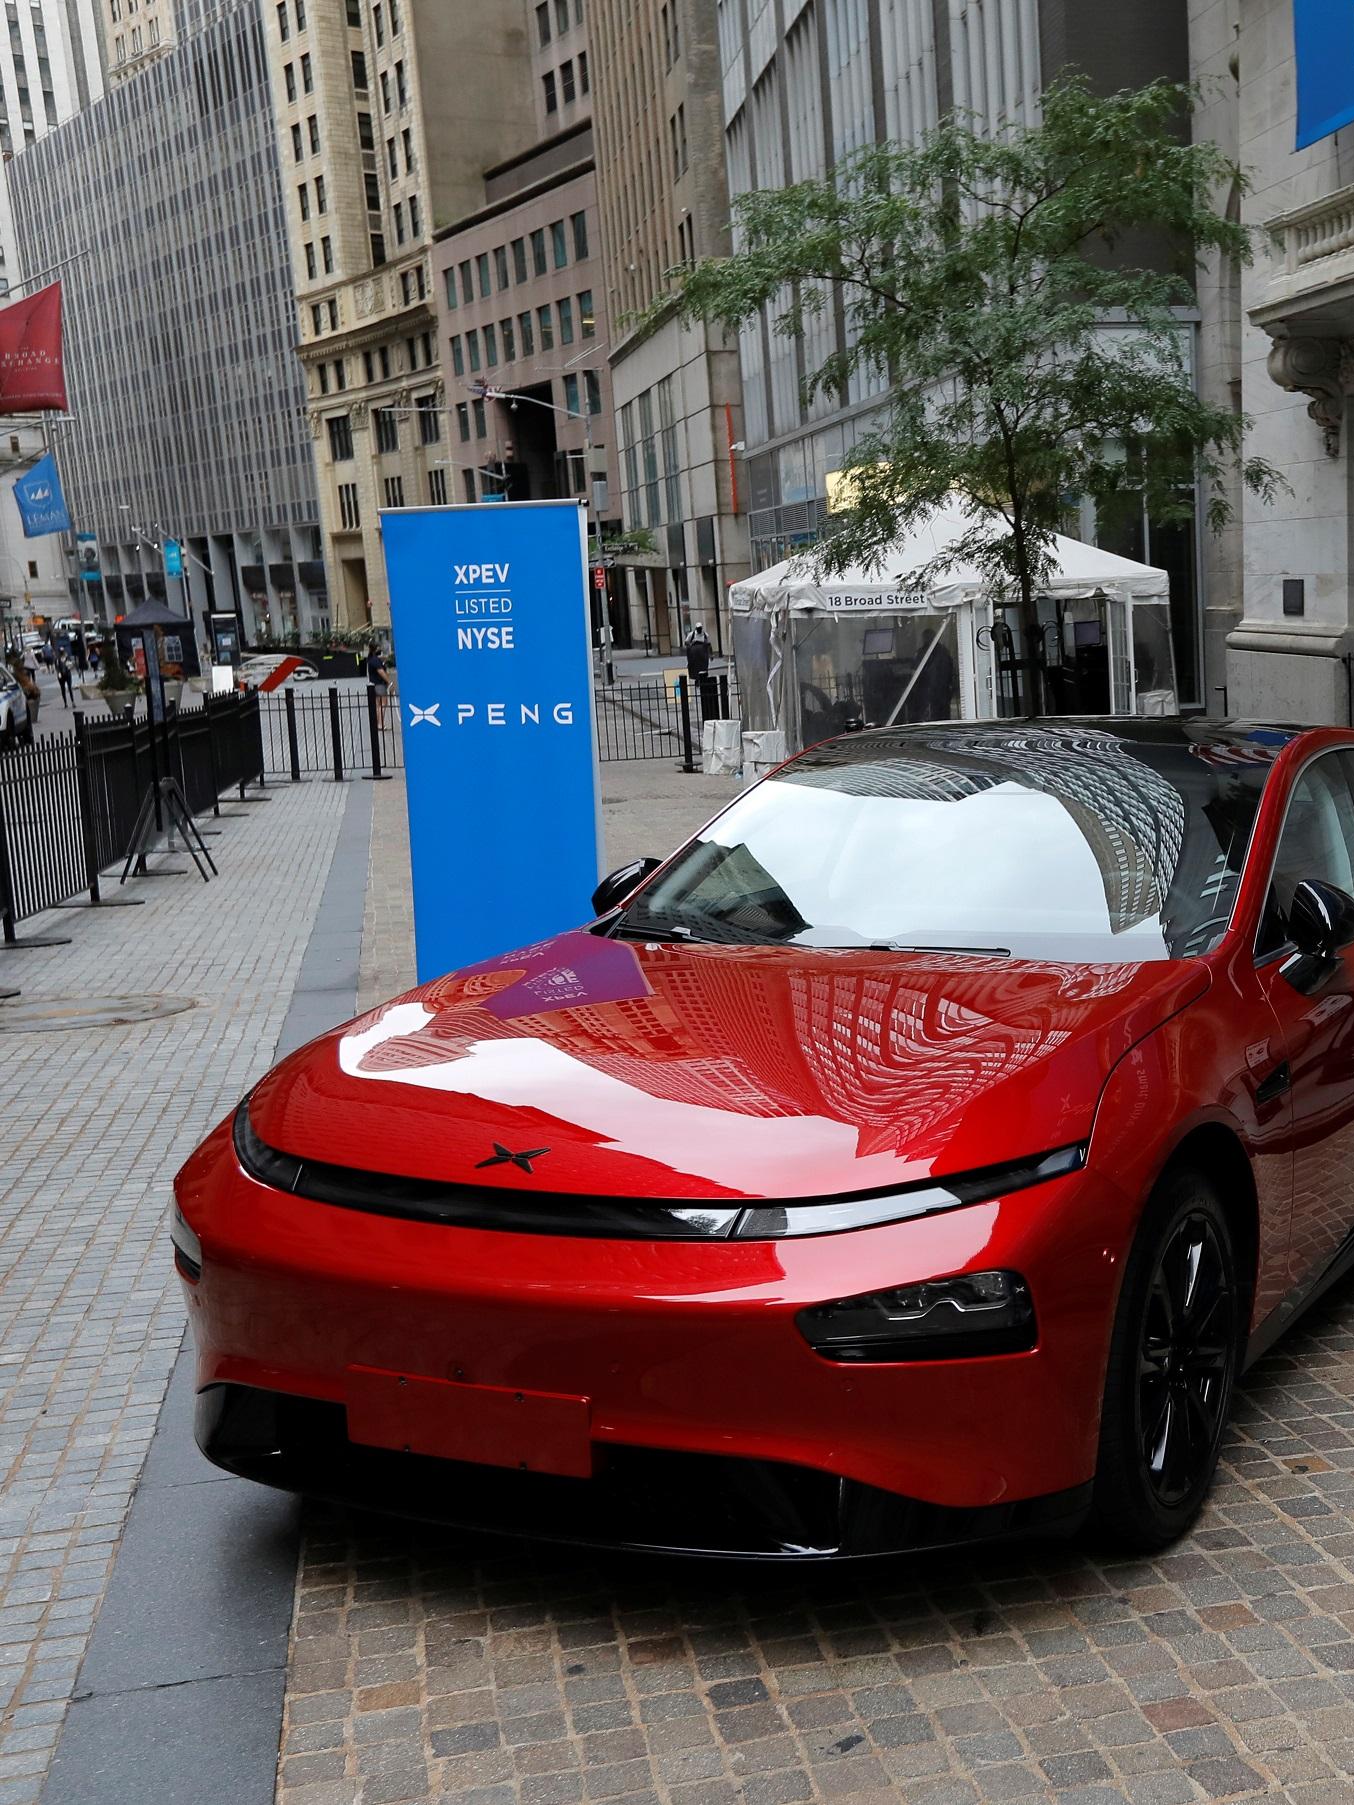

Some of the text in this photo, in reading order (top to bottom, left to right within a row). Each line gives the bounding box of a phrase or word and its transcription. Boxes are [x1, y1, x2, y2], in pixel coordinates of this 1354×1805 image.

[453, 563, 510, 585] XPEV
[455, 598, 512, 615] LISTED
[828, 594, 925, 606] 18 Broad Street
[457, 627, 515, 650] NYSE
